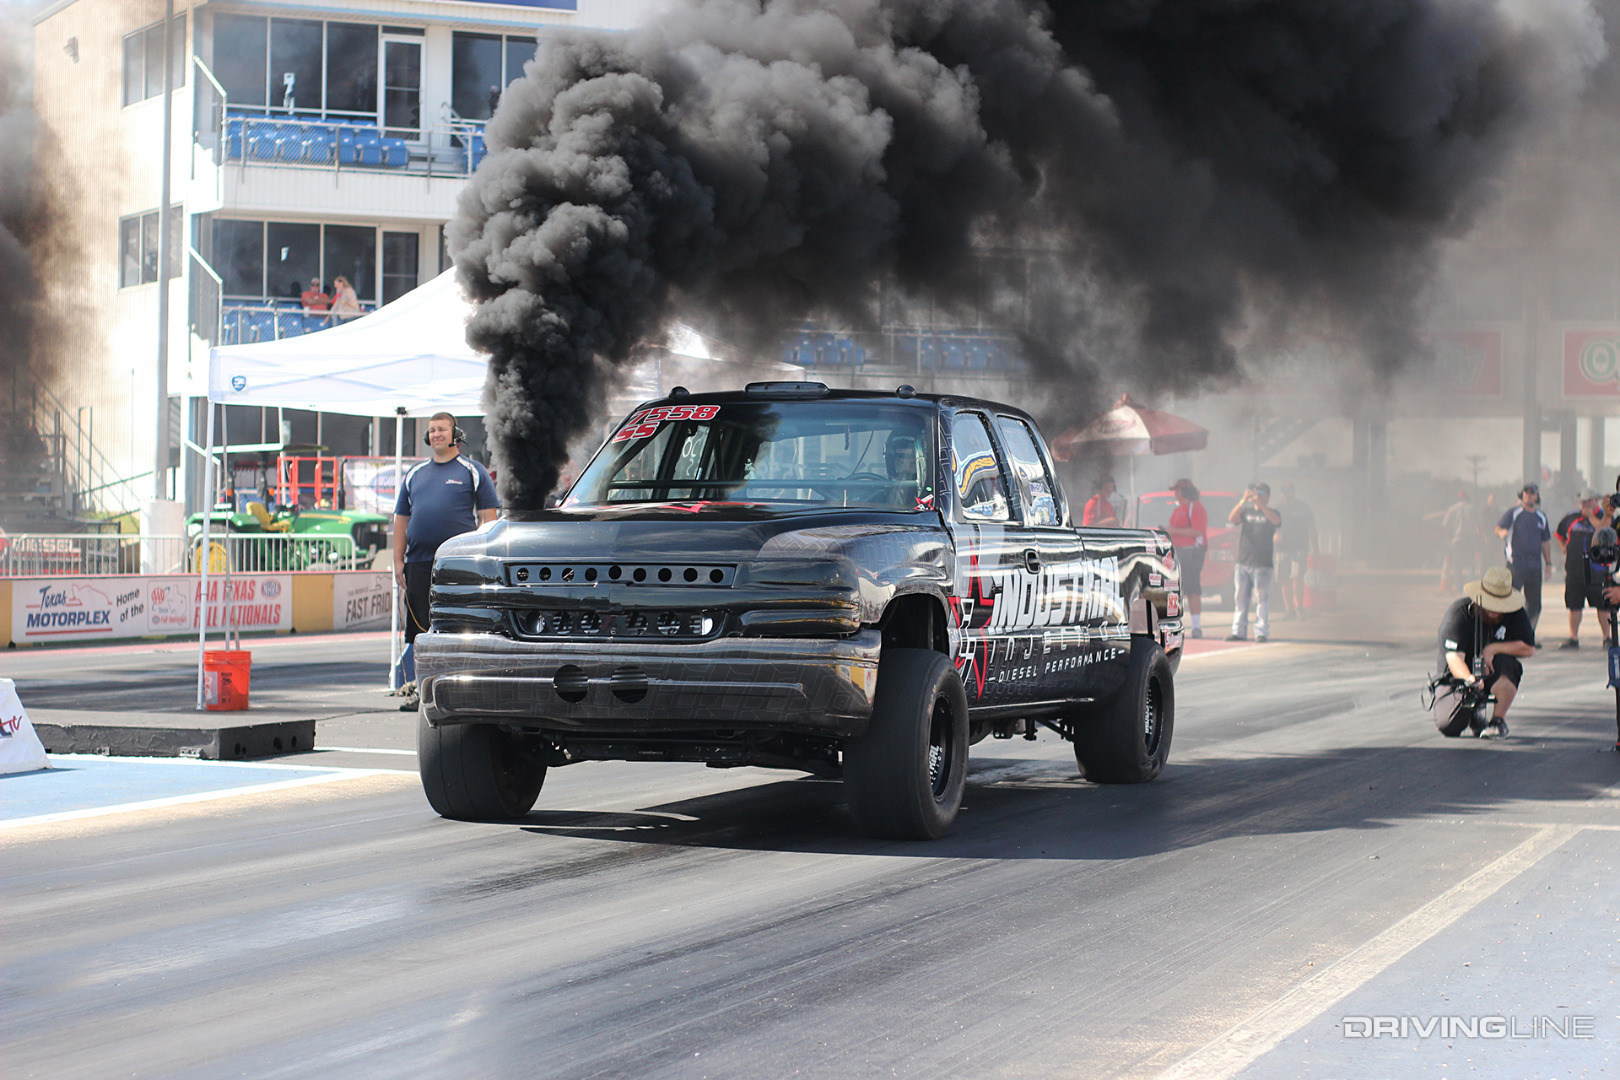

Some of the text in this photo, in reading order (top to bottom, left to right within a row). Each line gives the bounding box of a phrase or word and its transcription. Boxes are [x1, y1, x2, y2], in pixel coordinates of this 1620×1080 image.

[627, 405, 721, 427] 7558
[39, 585, 67, 611] Texas
[116, 589, 140, 607] Home
[346, 591, 392, 622] FAST FRID
[27, 610, 111, 628] MOTORPLEX
[120, 607, 129, 622] of
[131, 603, 144, 617] the
[193, 605, 217, 628] FLL
[1045, 647, 1116, 674] PERFORMANCE
